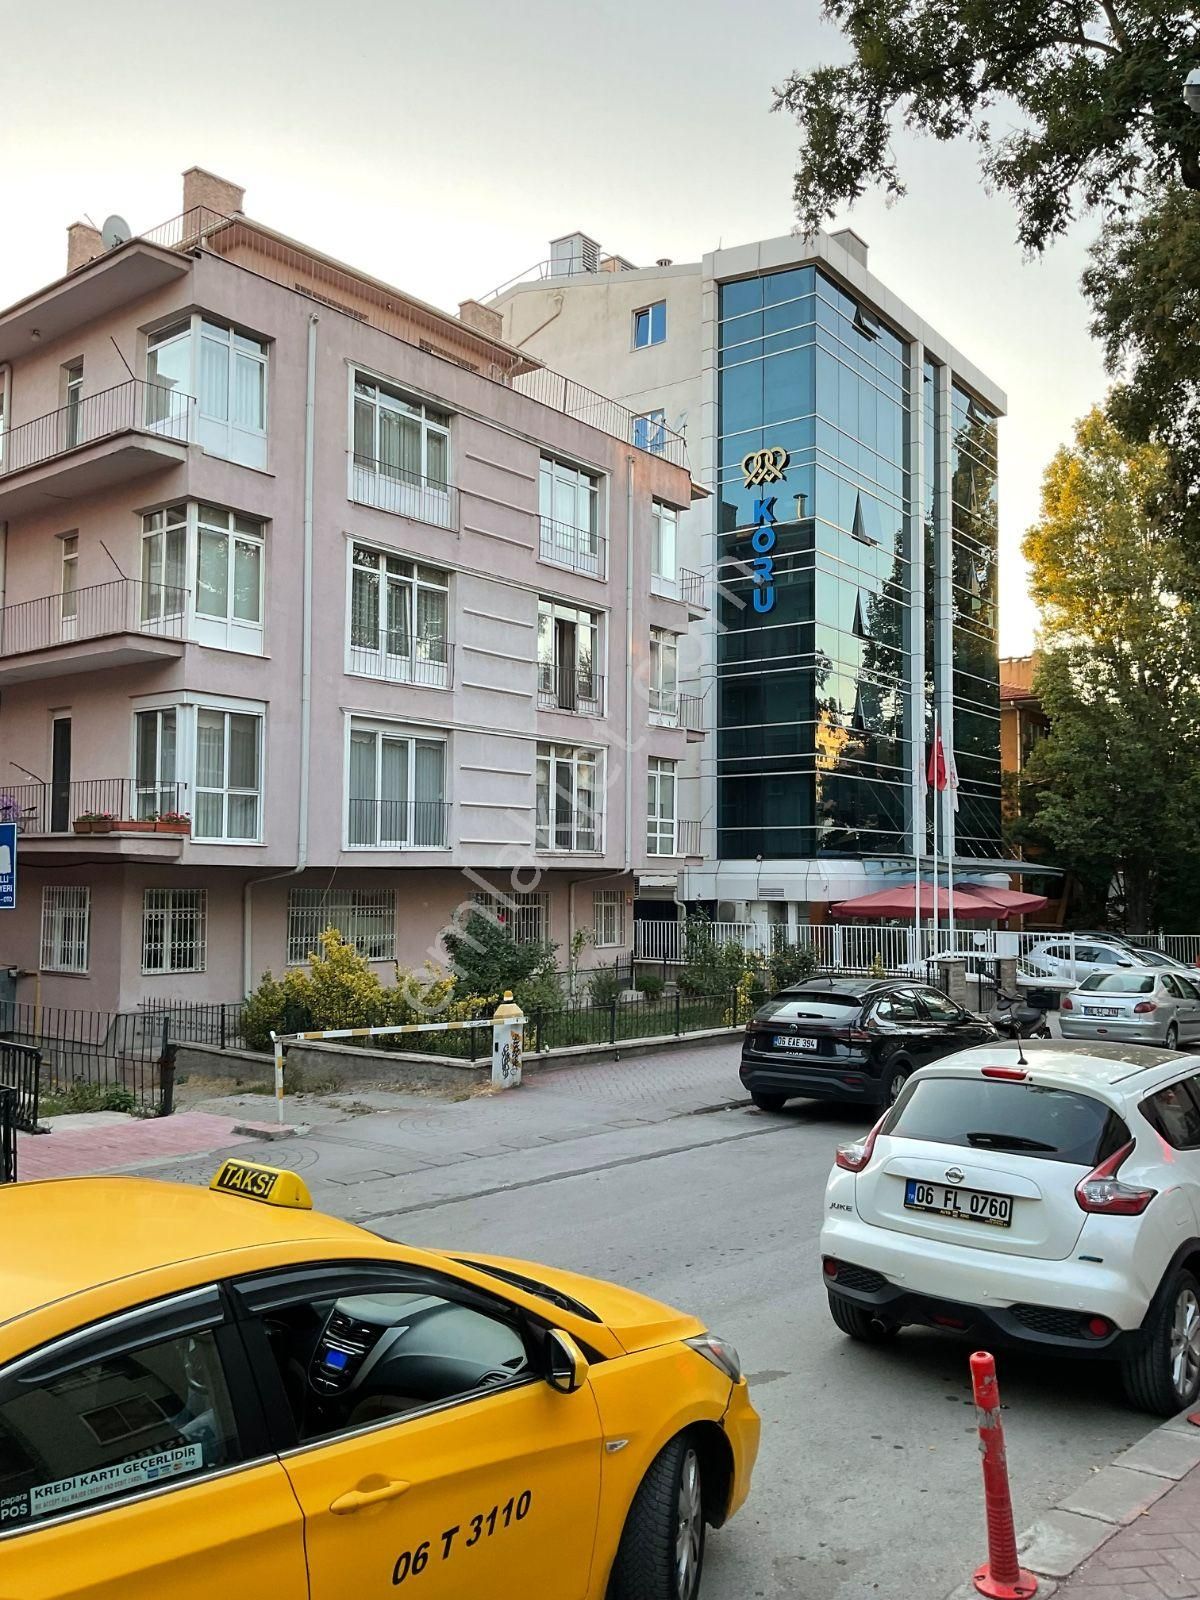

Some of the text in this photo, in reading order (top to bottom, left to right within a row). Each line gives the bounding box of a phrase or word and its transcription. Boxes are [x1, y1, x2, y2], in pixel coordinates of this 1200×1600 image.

[752, 497, 777, 613] KORU
[829, 1202, 853, 1212] JUKE
[916, 1185, 934, 1205] 06
[943, 1189, 962, 1210] FL
[969, 1194, 1008, 1219] 0760
[34, 1477, 77, 1499] KREDİ
[80, 1467, 119, 1487] KARTI
[122, 1447, 196, 1474] GEÇERLİDİR
[0, 1493, 28, 1508] papara
[0, 1503, 28, 1520] POS
[392, 1489, 532, 1586] 06 T 3110
